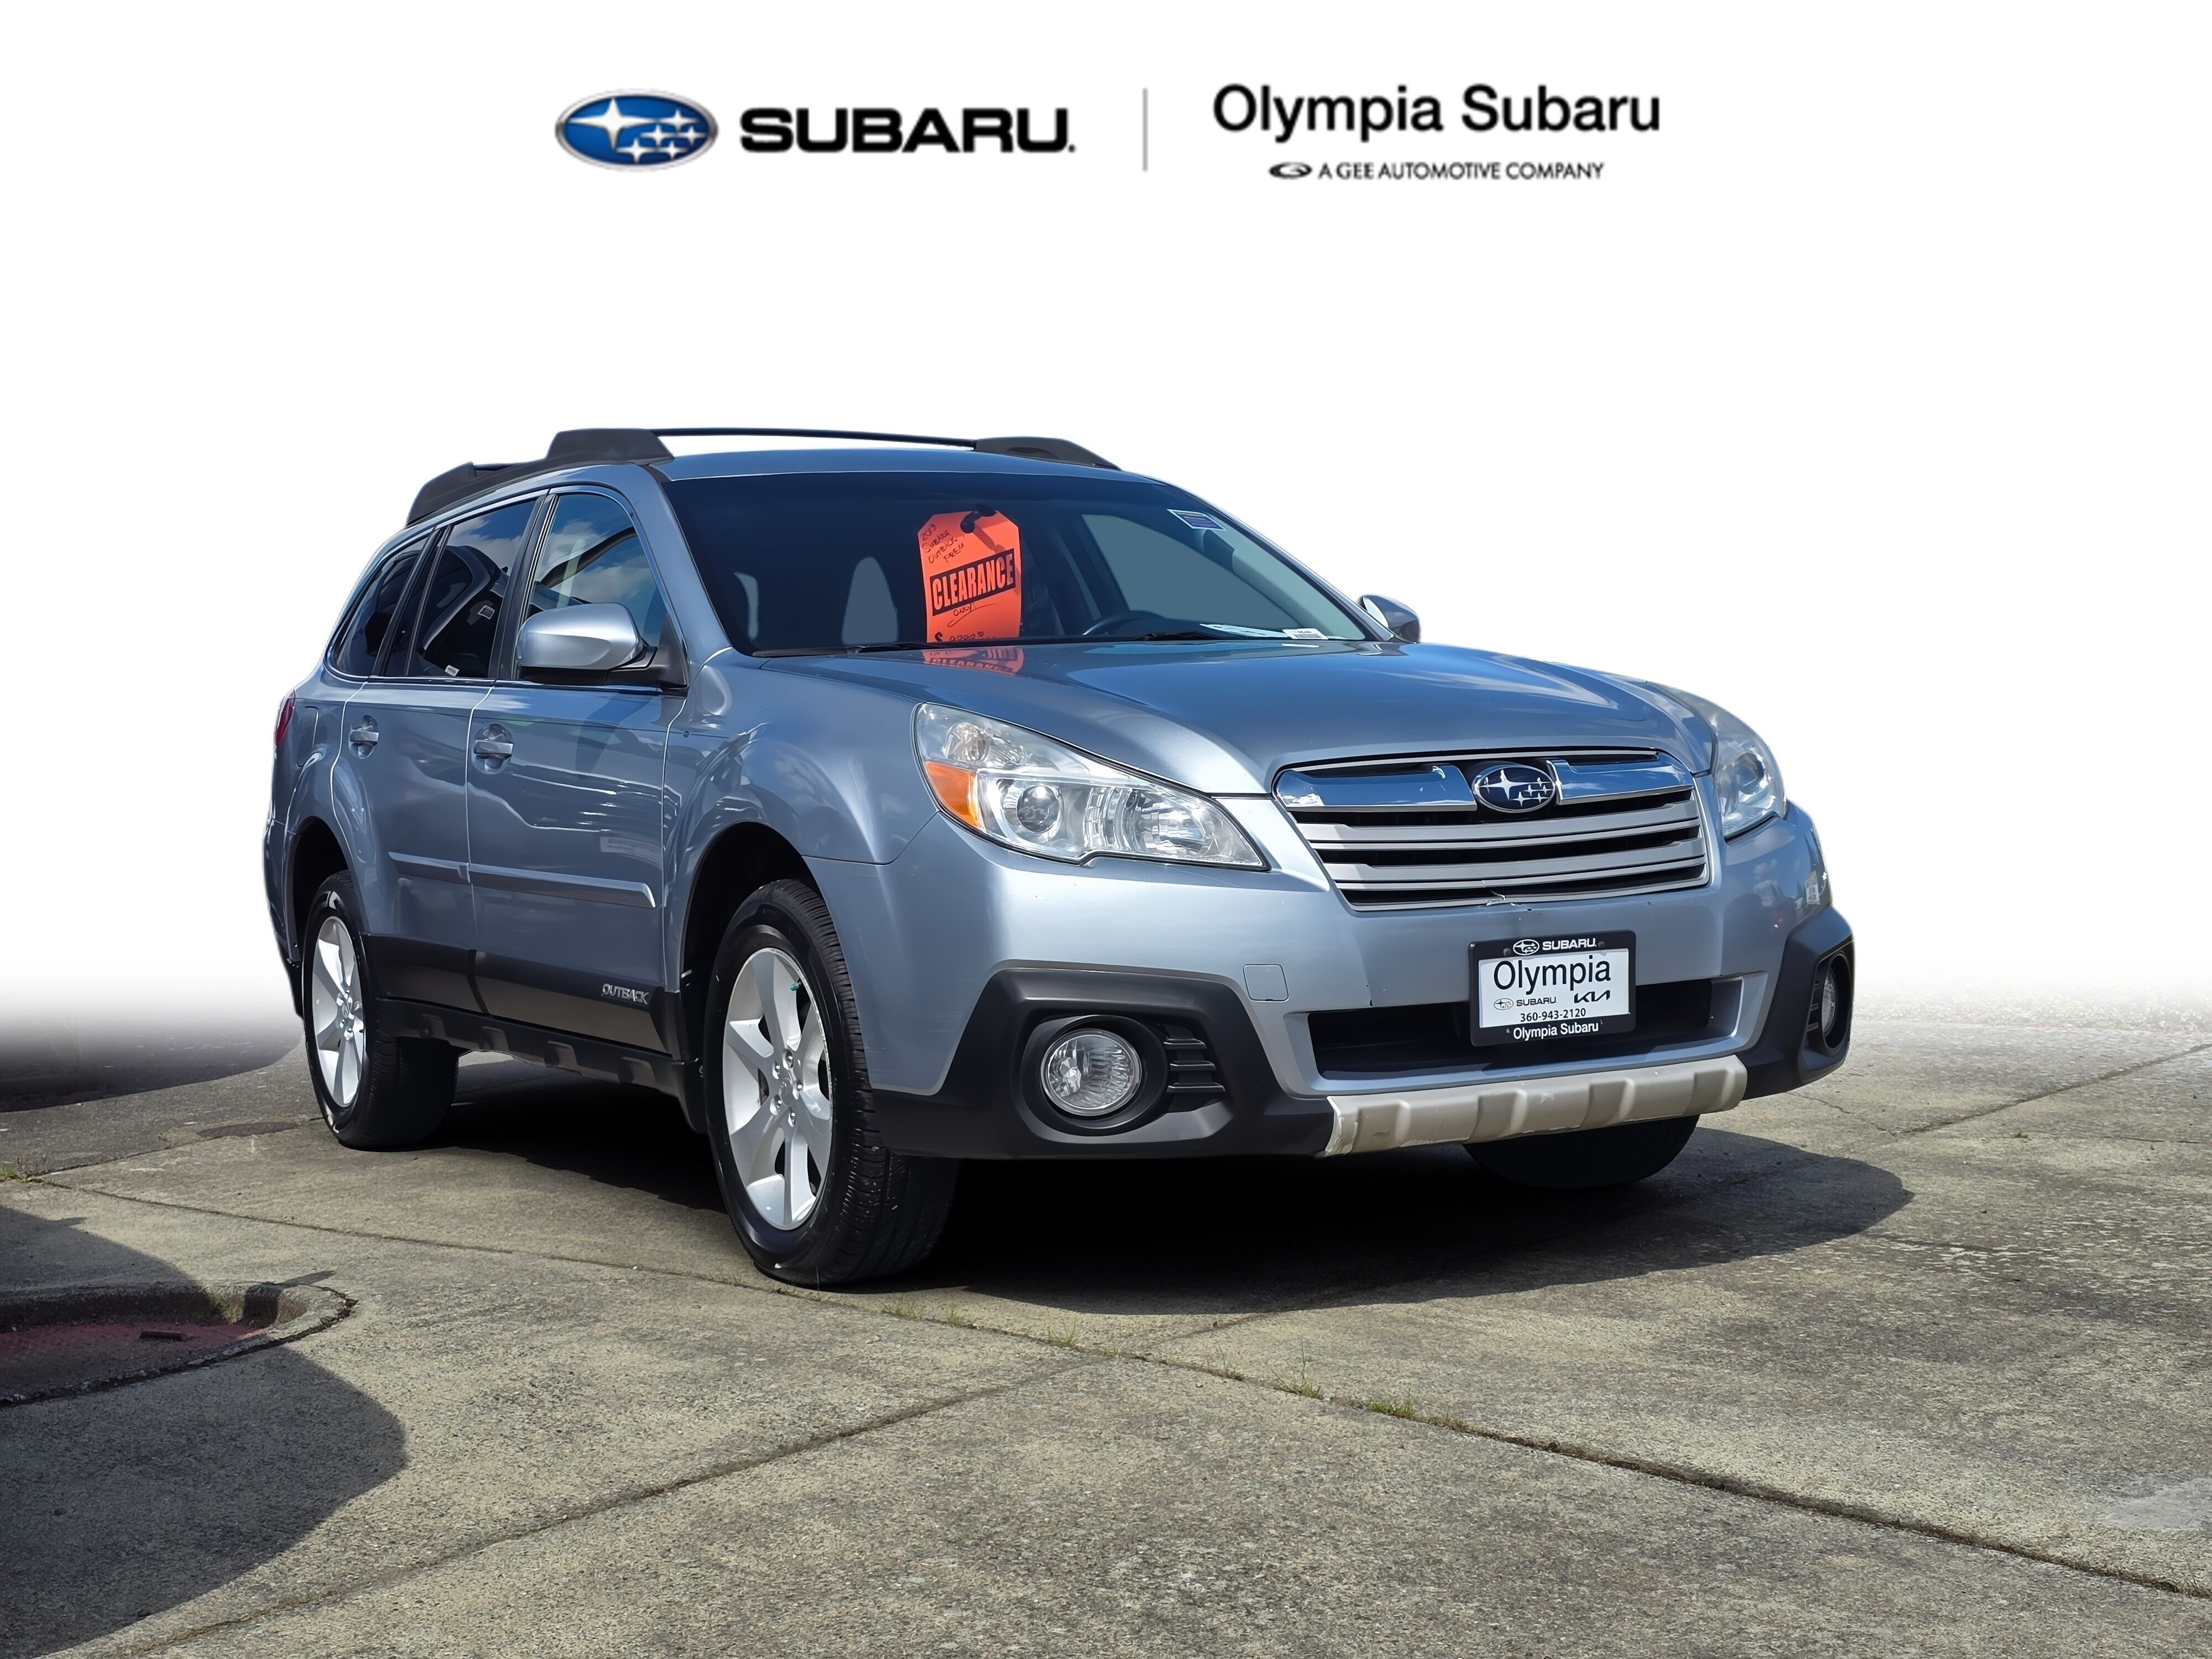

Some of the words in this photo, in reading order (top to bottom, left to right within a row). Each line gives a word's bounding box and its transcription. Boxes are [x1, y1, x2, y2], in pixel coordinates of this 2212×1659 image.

[920, 523, 937, 541] 2013
[932, 553, 1014, 611] CLEARANCE
[1493, 954, 1611, 995] Olympia
[602, 983, 650, 1005] OUTBACK
[1520, 1008, 1587, 1022] 360-943-2120
[1512, 1024, 1558, 1041] Olympia
[1560, 1022, 1599, 1035] Subaru
